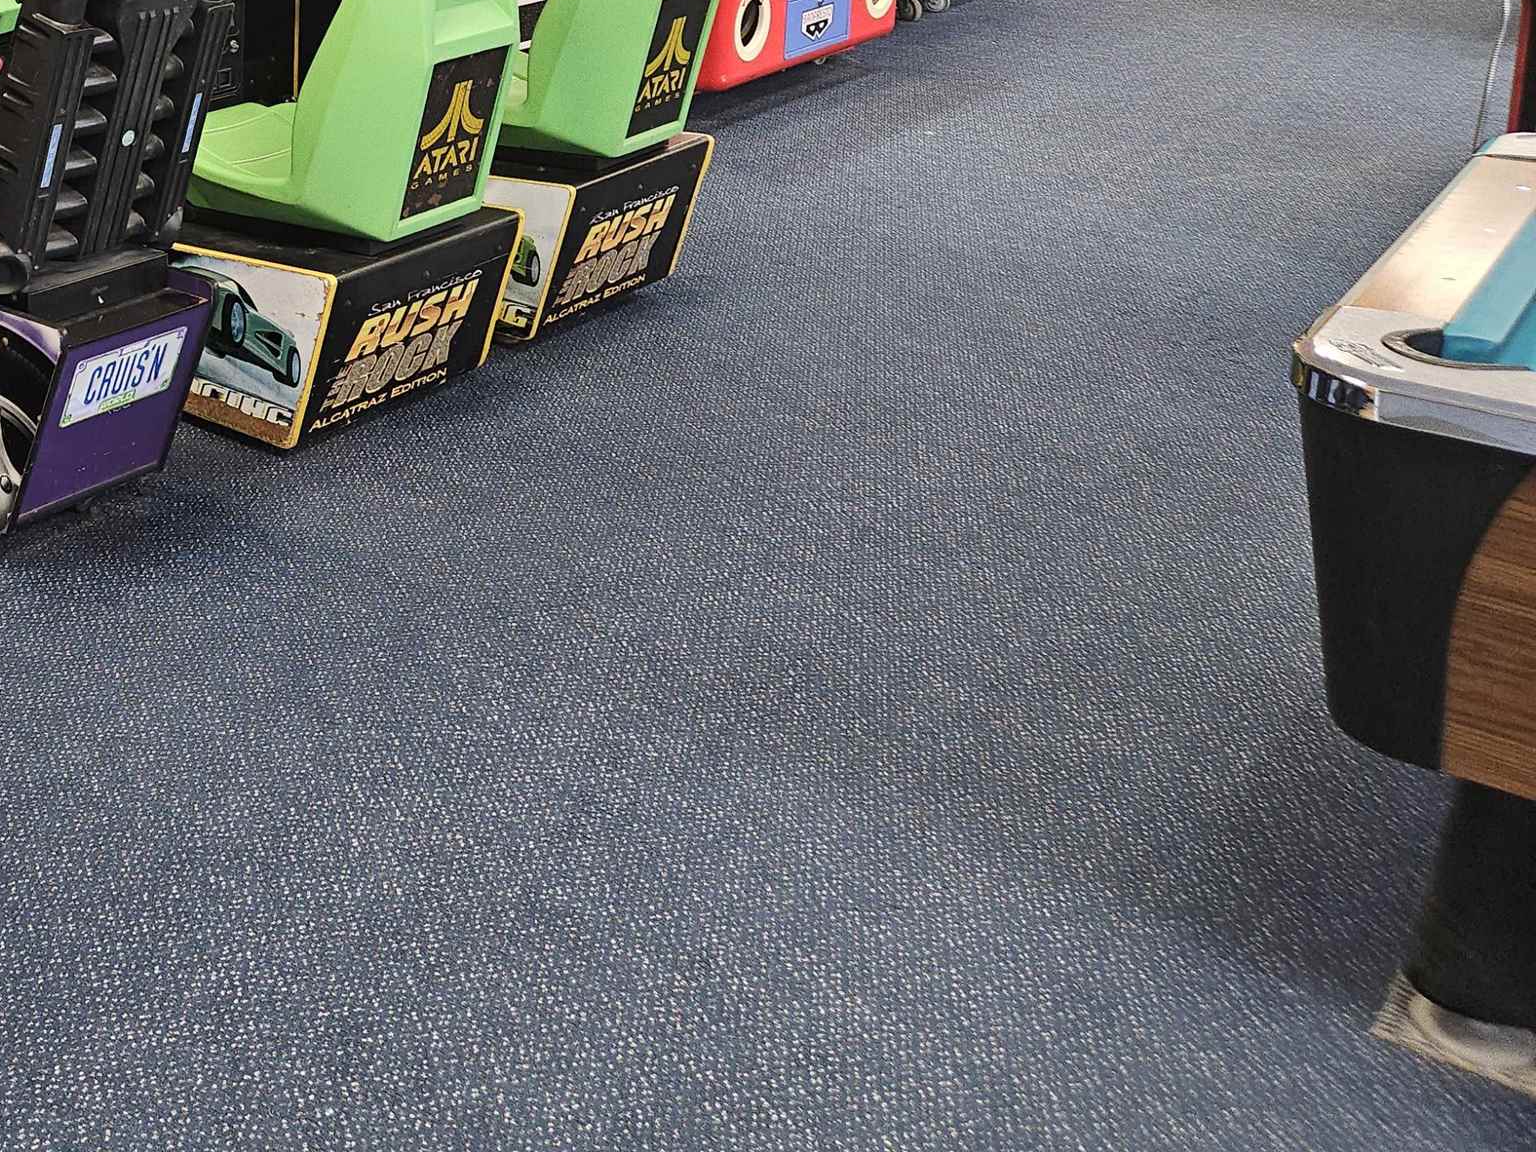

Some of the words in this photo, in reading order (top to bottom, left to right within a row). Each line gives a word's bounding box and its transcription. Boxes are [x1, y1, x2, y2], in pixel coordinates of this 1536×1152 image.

[637, 67, 686, 104] ATARI
[410, 163, 473, 190] GAMES
[413, 136, 480, 180] ATARI
[574, 193, 677, 264] RUSH
[590, 209, 620, 225] San
[624, 185, 680, 210] Francisco
[368, 298, 402, 317] San
[408, 269, 483, 300] Francisco
[561, 230, 662, 305] ROCK
[345, 278, 480, 363] RUSH
[543, 293, 602, 326] ALCATRAZ
[603, 273, 646, 298] EDITION
[83, 342, 168, 405] CRUIS'N
[332, 320, 464, 409] ROCK
[309, 392, 388, 433] ALCATRAZ
[391, 367, 448, 399] EDITION
